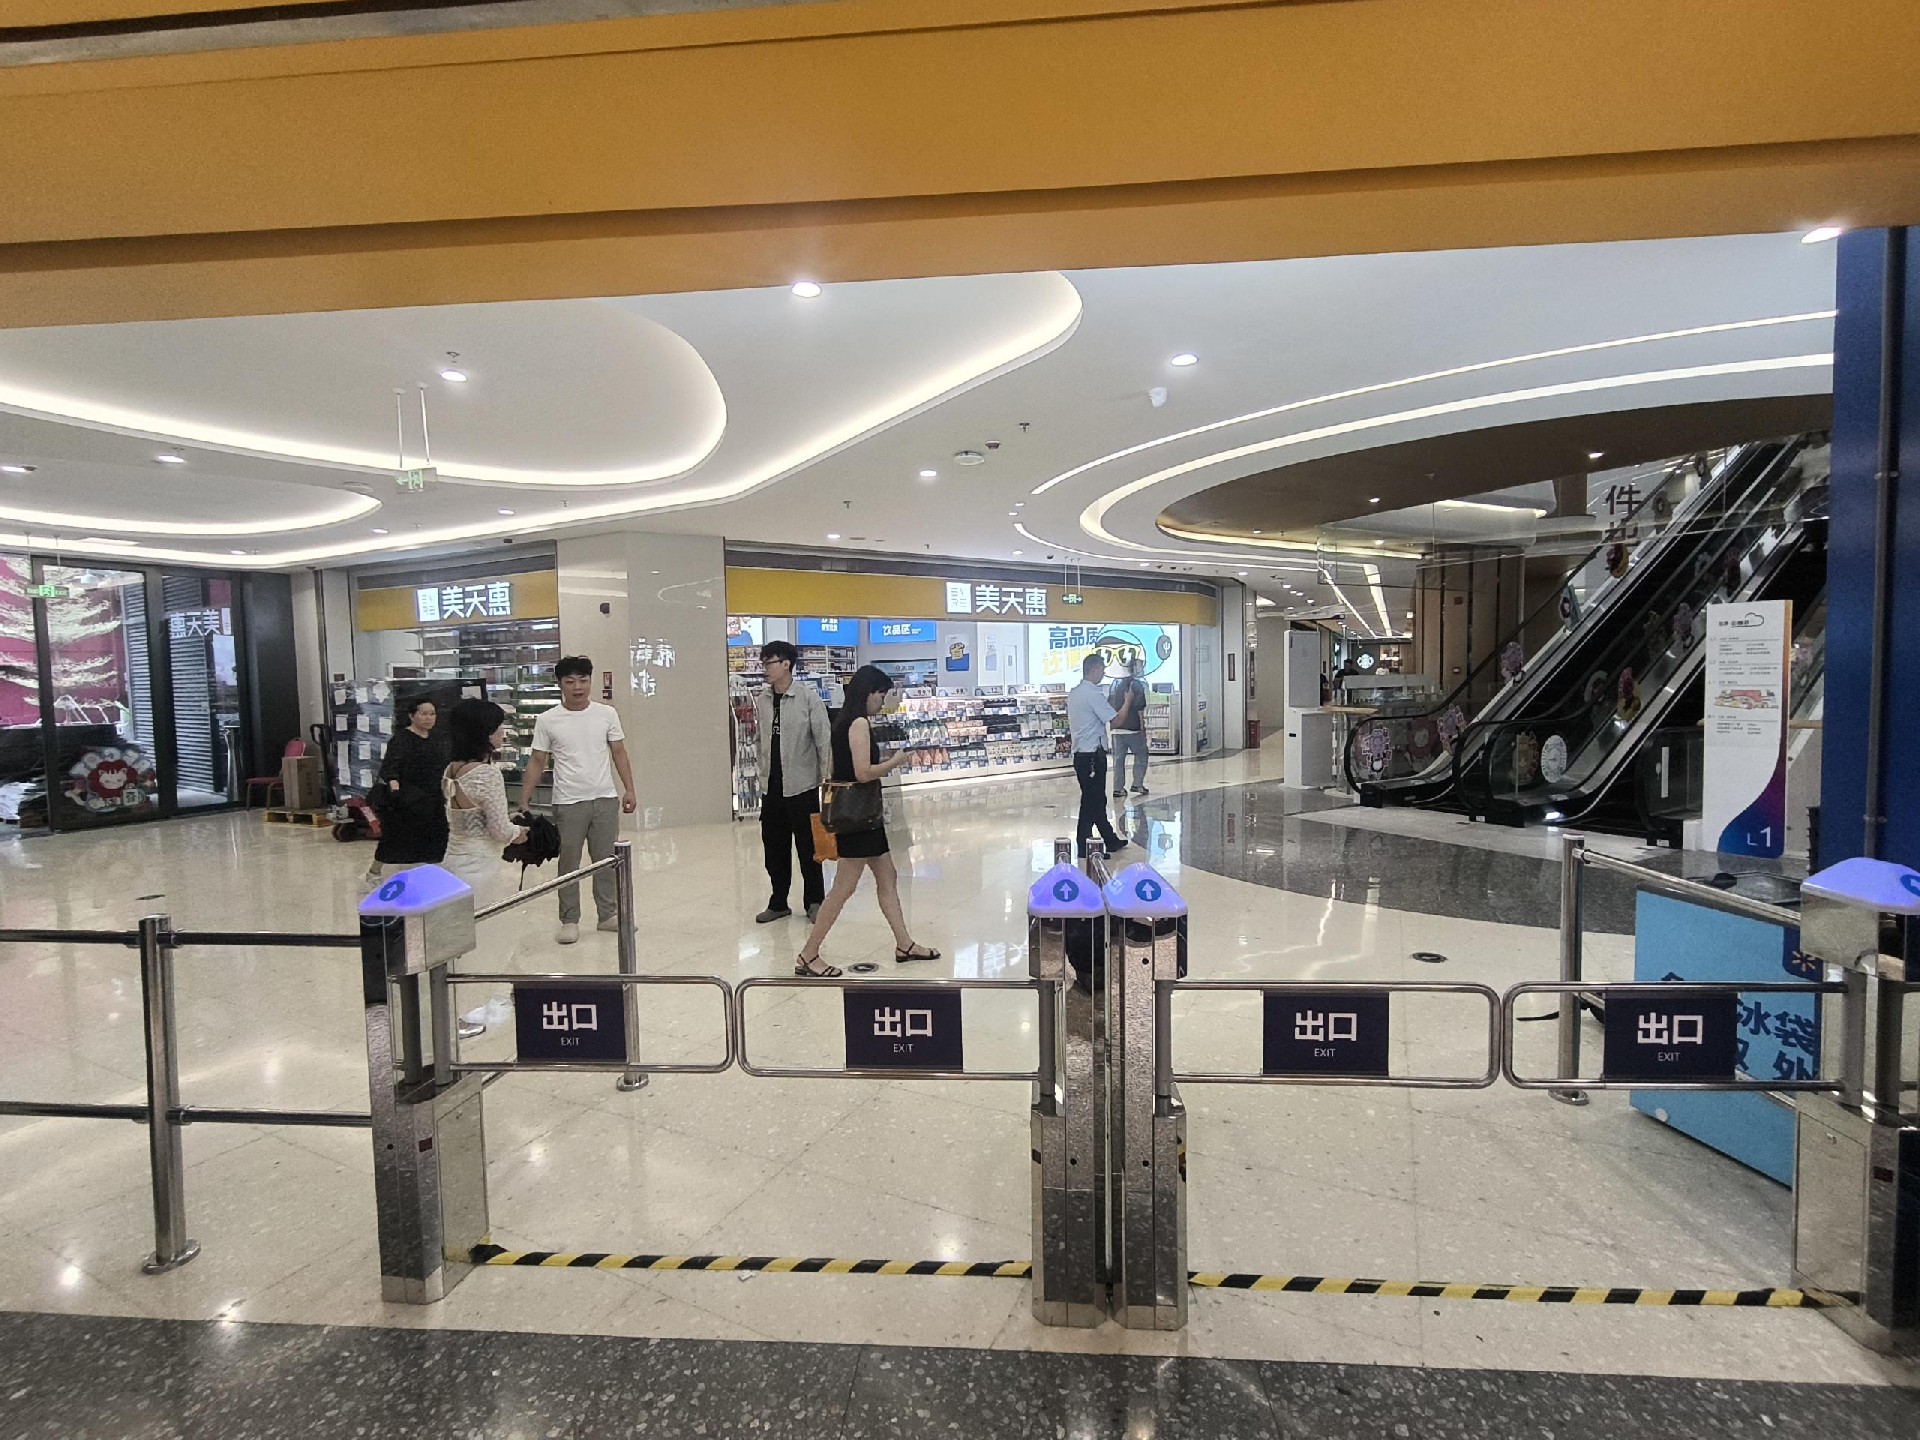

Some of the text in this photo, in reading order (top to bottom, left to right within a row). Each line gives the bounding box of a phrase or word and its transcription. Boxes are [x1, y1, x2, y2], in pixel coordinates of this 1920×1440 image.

[441, 582, 511, 620] 美天惠
[975, 585, 1047, 616] 美天惠
[1048, 626, 1100, 649] 高品质
[542, 1001, 598, 1031] 出口
[873, 1006, 933, 1038] 出口
[1294, 1010, 1357, 1042] 出口
[1637, 1012, 1704, 1046] 出口
[560, 1037, 582, 1047] EXIT
[892, 1043, 915, 1053] EXIT
[1313, 1047, 1337, 1057] EXIT
[1657, 1052, 1680, 1062] EXIT
